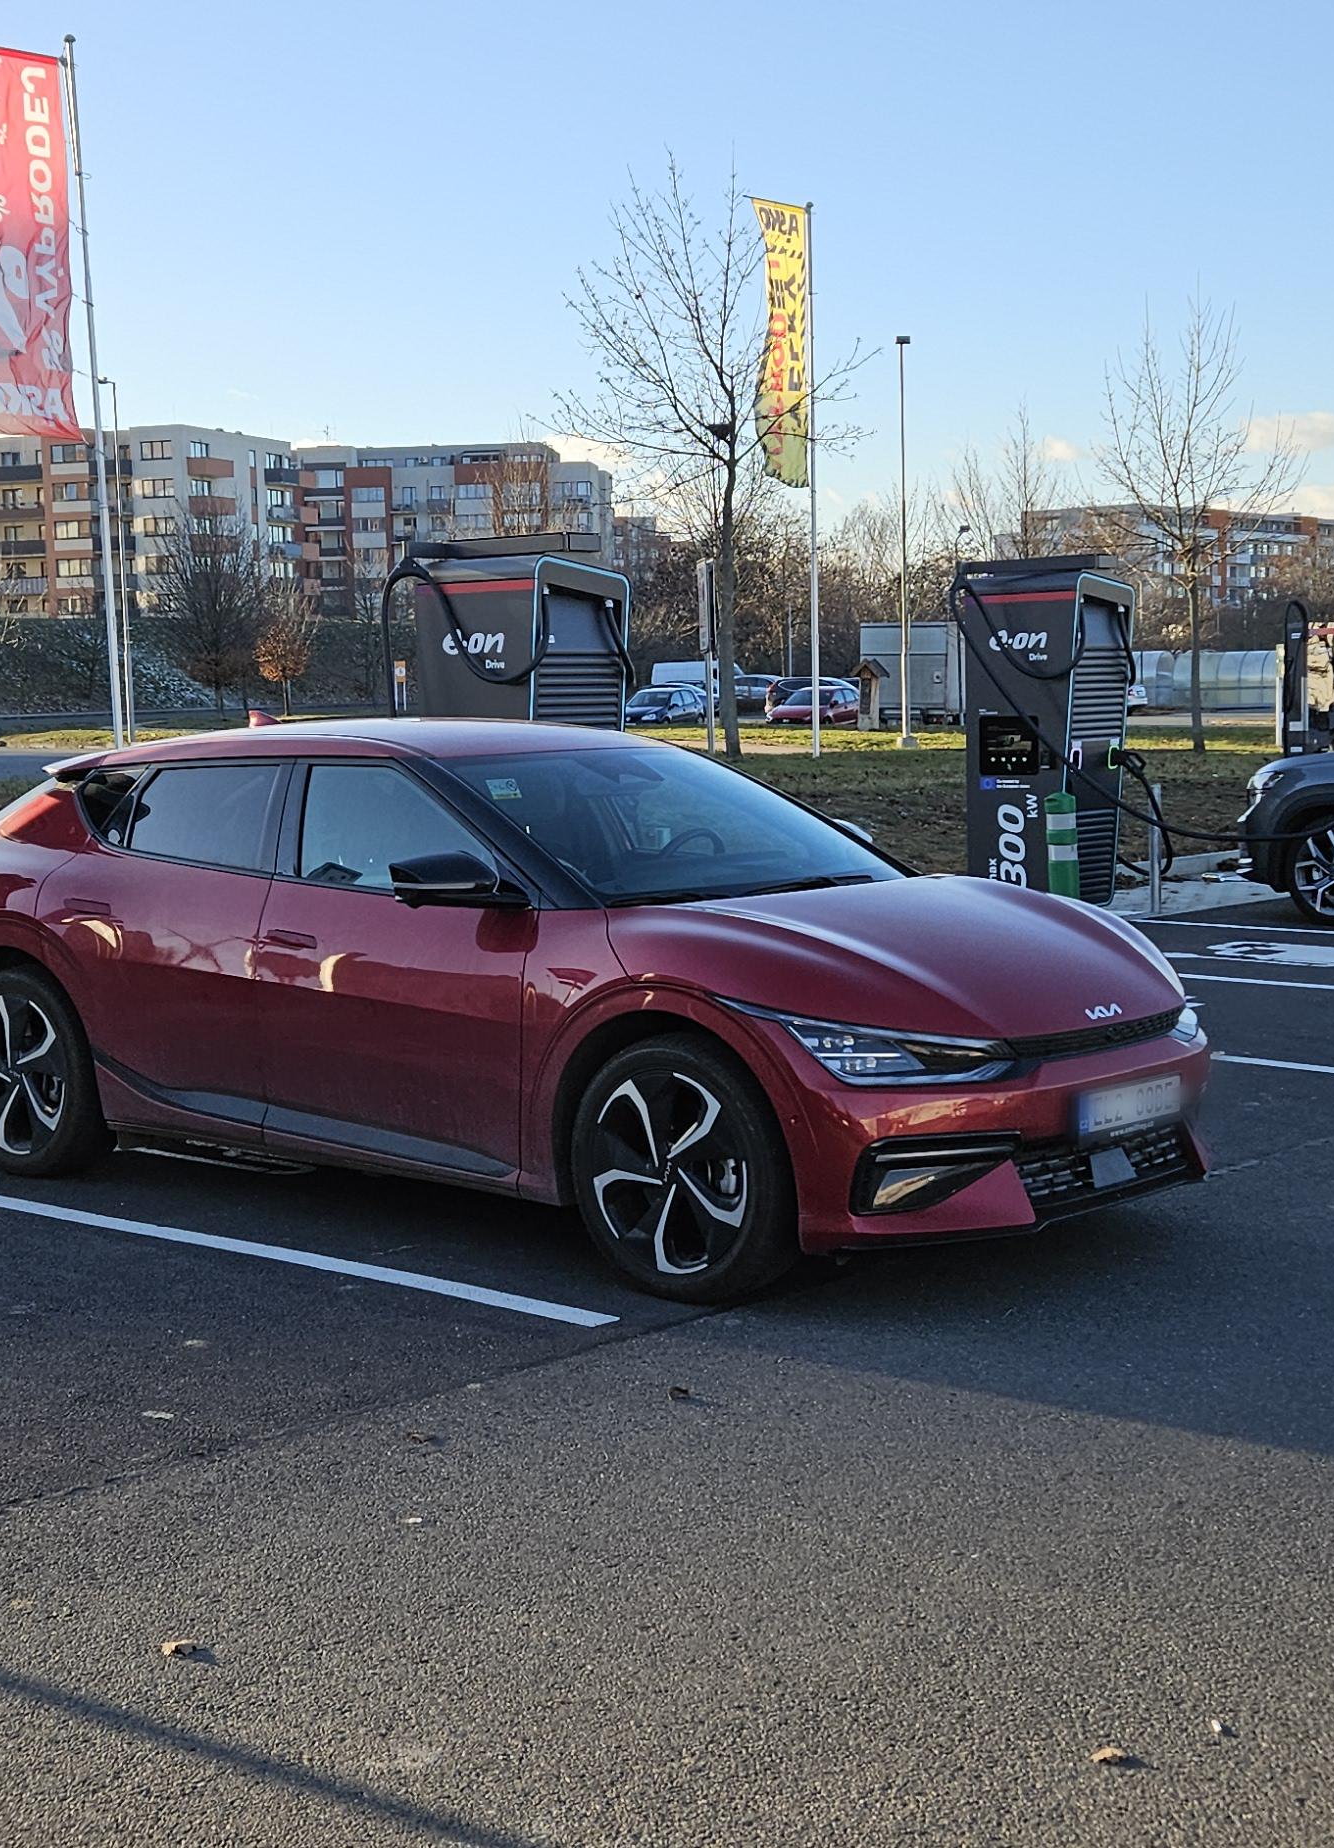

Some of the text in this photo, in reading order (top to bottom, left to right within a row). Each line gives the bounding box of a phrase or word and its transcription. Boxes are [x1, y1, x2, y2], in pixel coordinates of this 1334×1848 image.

[485, 659, 505, 669] Drive
[1029, 652, 1048, 661] Drive
[1026, 794, 1038, 818] kW
[997, 803, 1028, 889] 300
